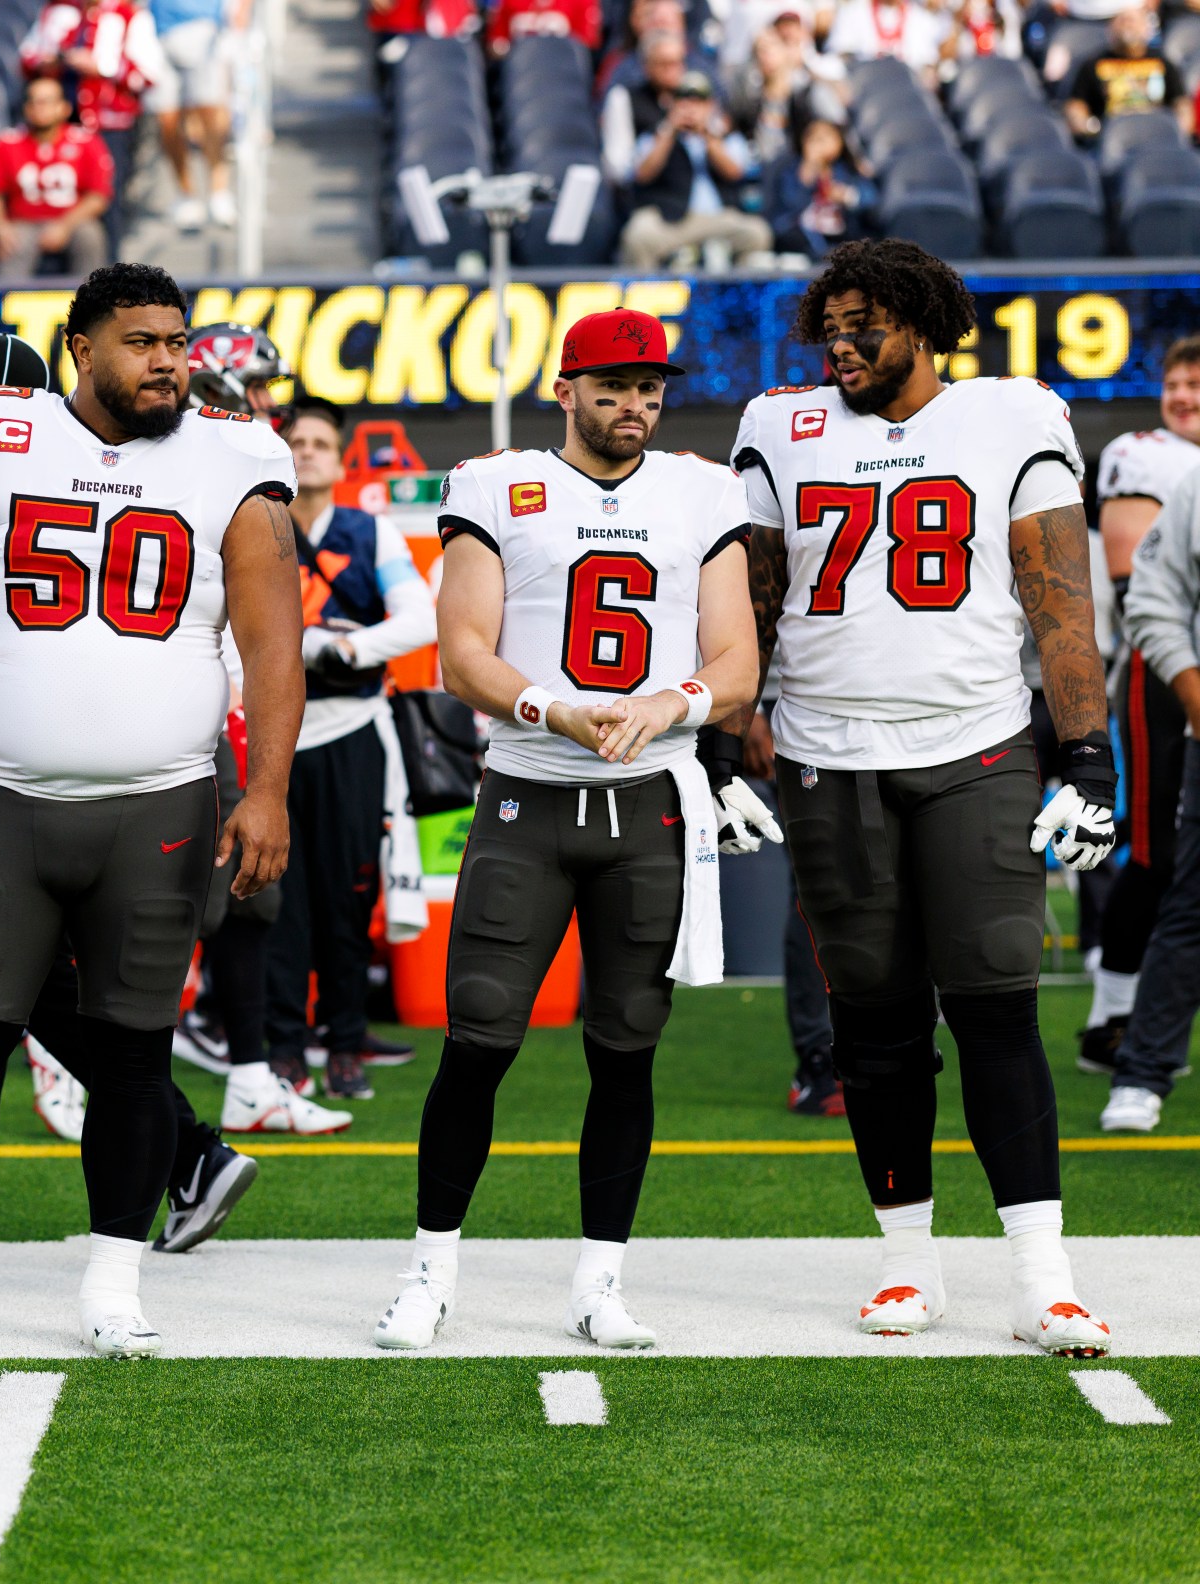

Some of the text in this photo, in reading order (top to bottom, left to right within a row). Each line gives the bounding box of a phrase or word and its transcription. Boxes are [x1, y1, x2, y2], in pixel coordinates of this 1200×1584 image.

[3, 492, 196, 642] 50
[796, 474, 977, 617] 78
[560, 549, 659, 696] 6
